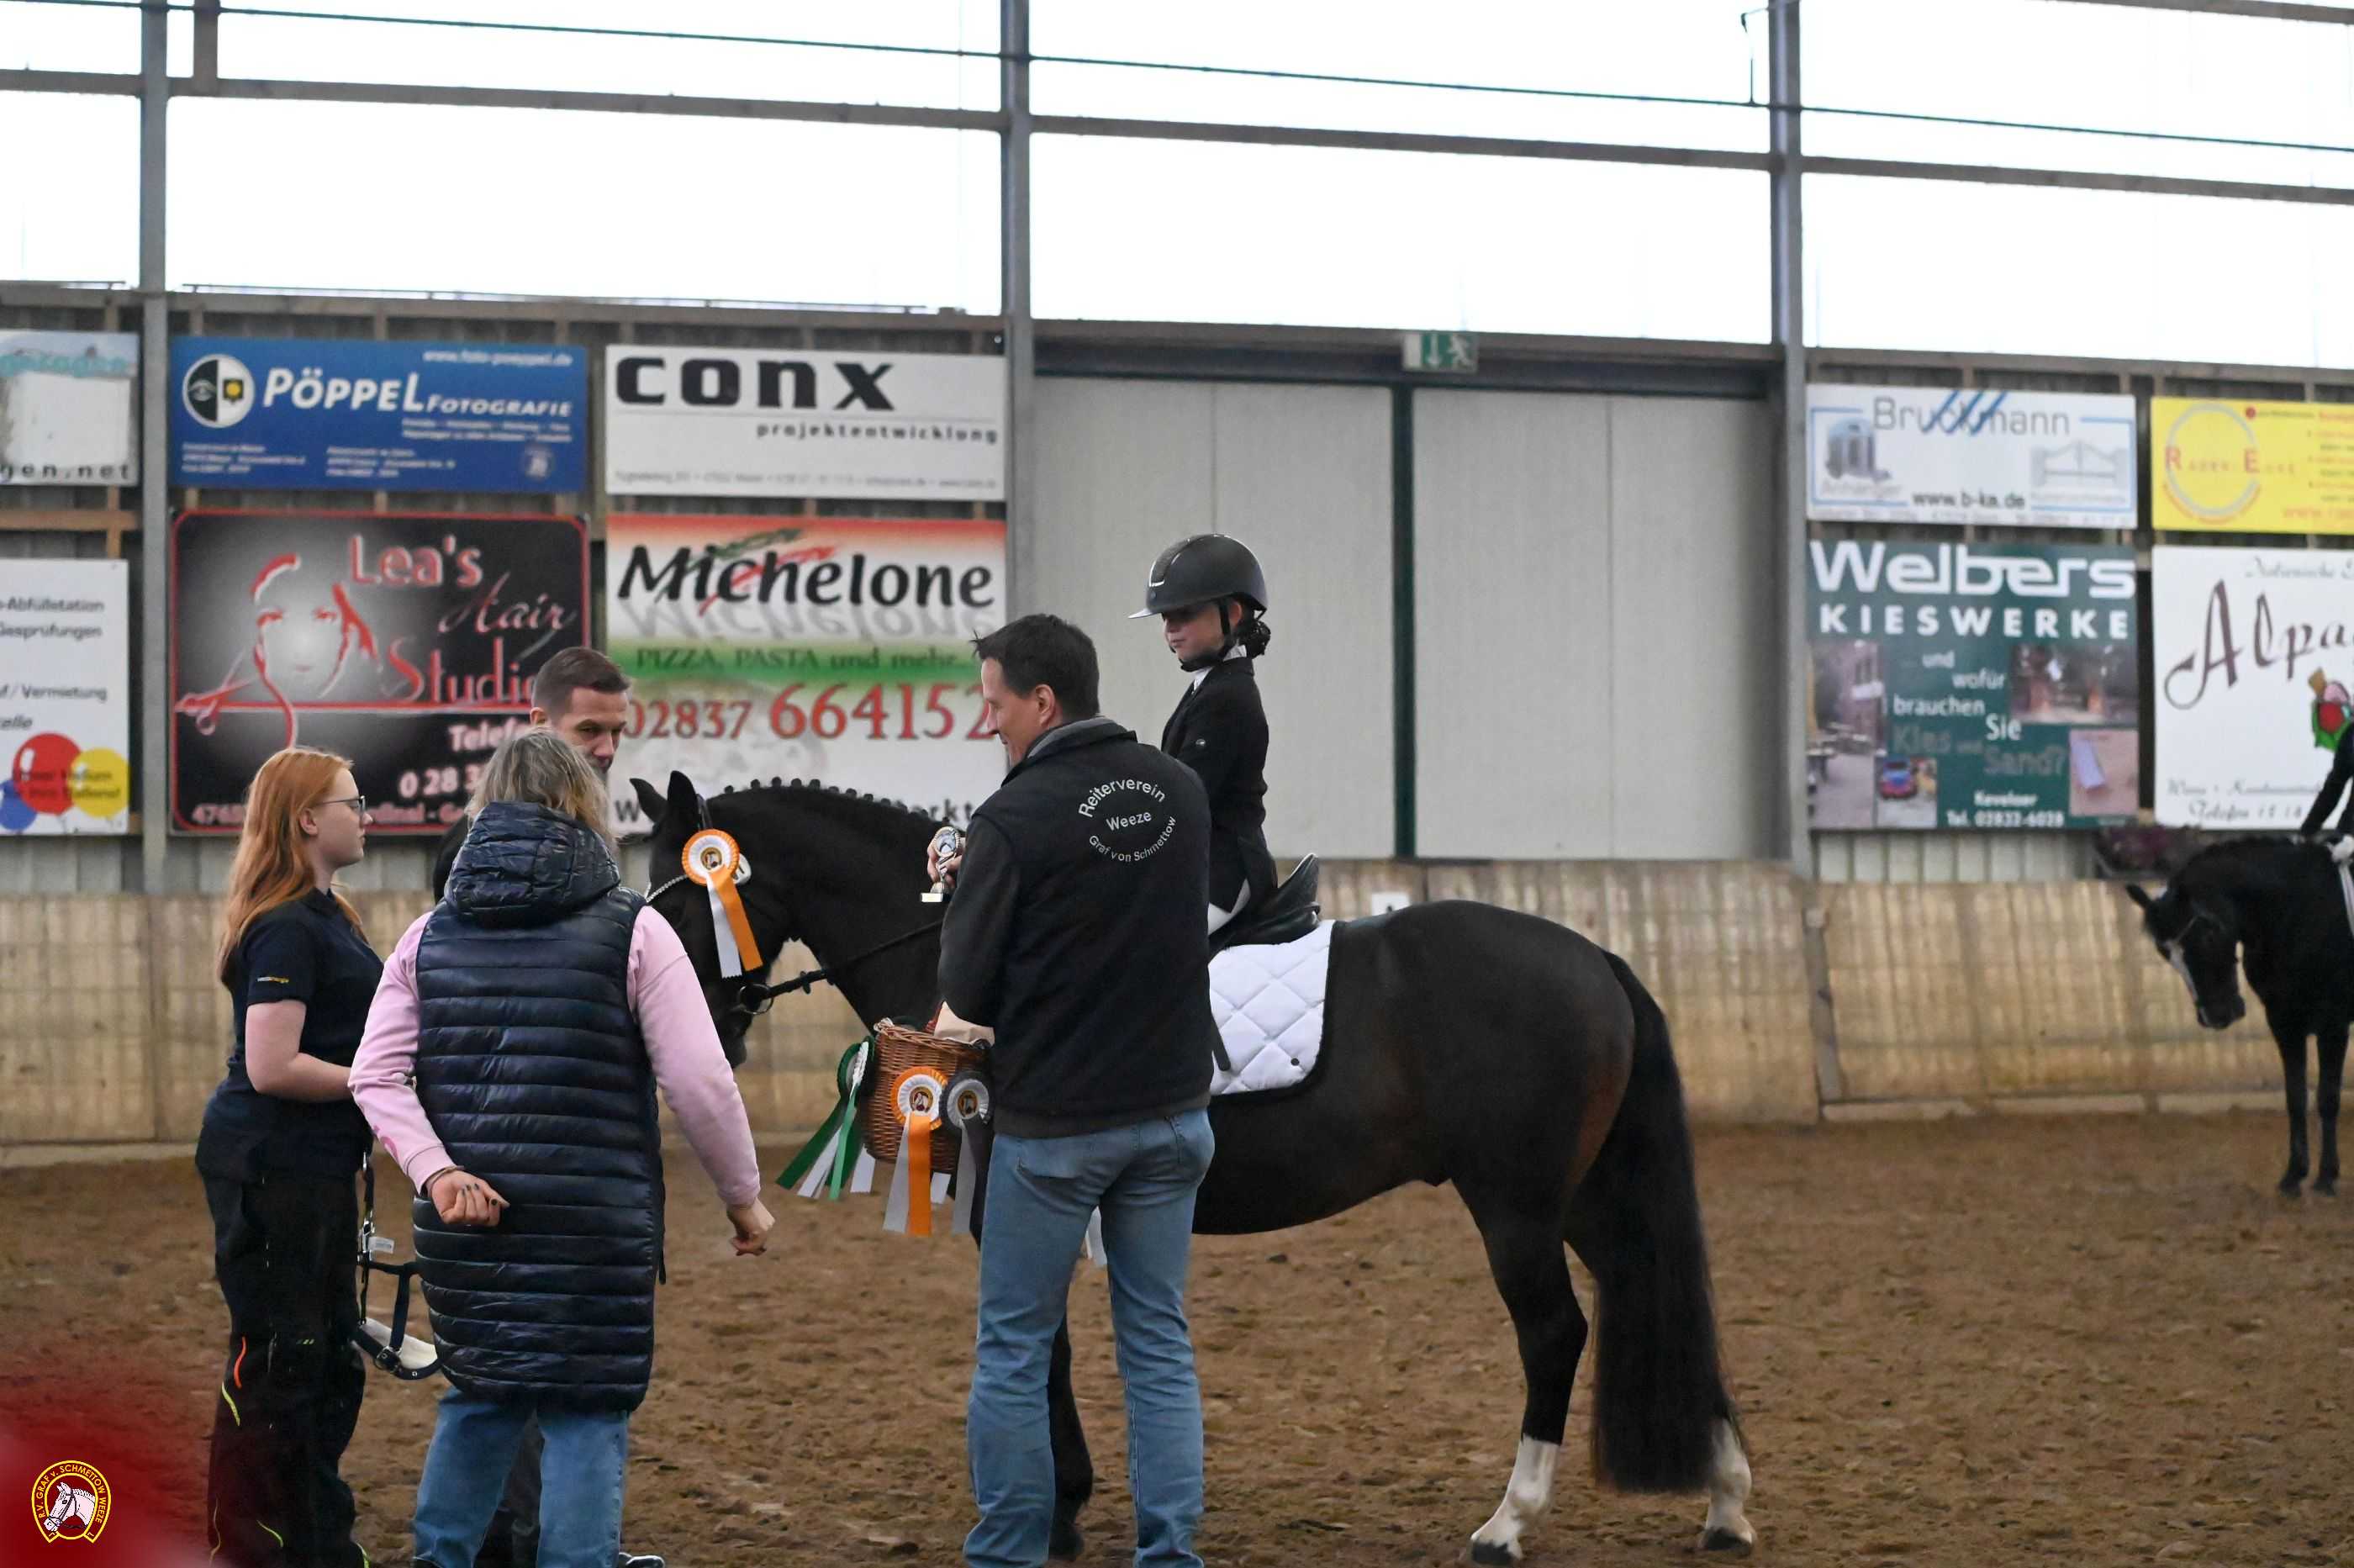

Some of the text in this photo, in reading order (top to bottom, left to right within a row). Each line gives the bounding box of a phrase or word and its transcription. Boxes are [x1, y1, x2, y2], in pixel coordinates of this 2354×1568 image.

[616, 356, 895, 411] conx
[757, 423, 998, 444] projektentwicklung
[349, 534, 483, 587] Lea's
[617, 544, 995, 608] Michelone
[1810, 541, 2137, 598] Welbers
[437, 572, 577, 646] Hair
[1819, 604, 2129, 639] KIESWERKE
[735, 649, 818, 668] PASTA
[830, 649, 880, 668] und
[1922, 650, 1956, 669] und
[22, 685, 107, 702] Vermietung
[1951, 668, 2006, 690] wofür
[769, 682, 995, 741] 664152
[1893, 694, 1985, 715] brauchen
[1984, 714, 2022, 741] Sie
[423, 766, 459, 796] 28
[1078, 779, 1166, 818] Reiterverein
[1106, 811, 1152, 832] Weeze
[1090, 816, 1177, 863] Graf von Schmettow
